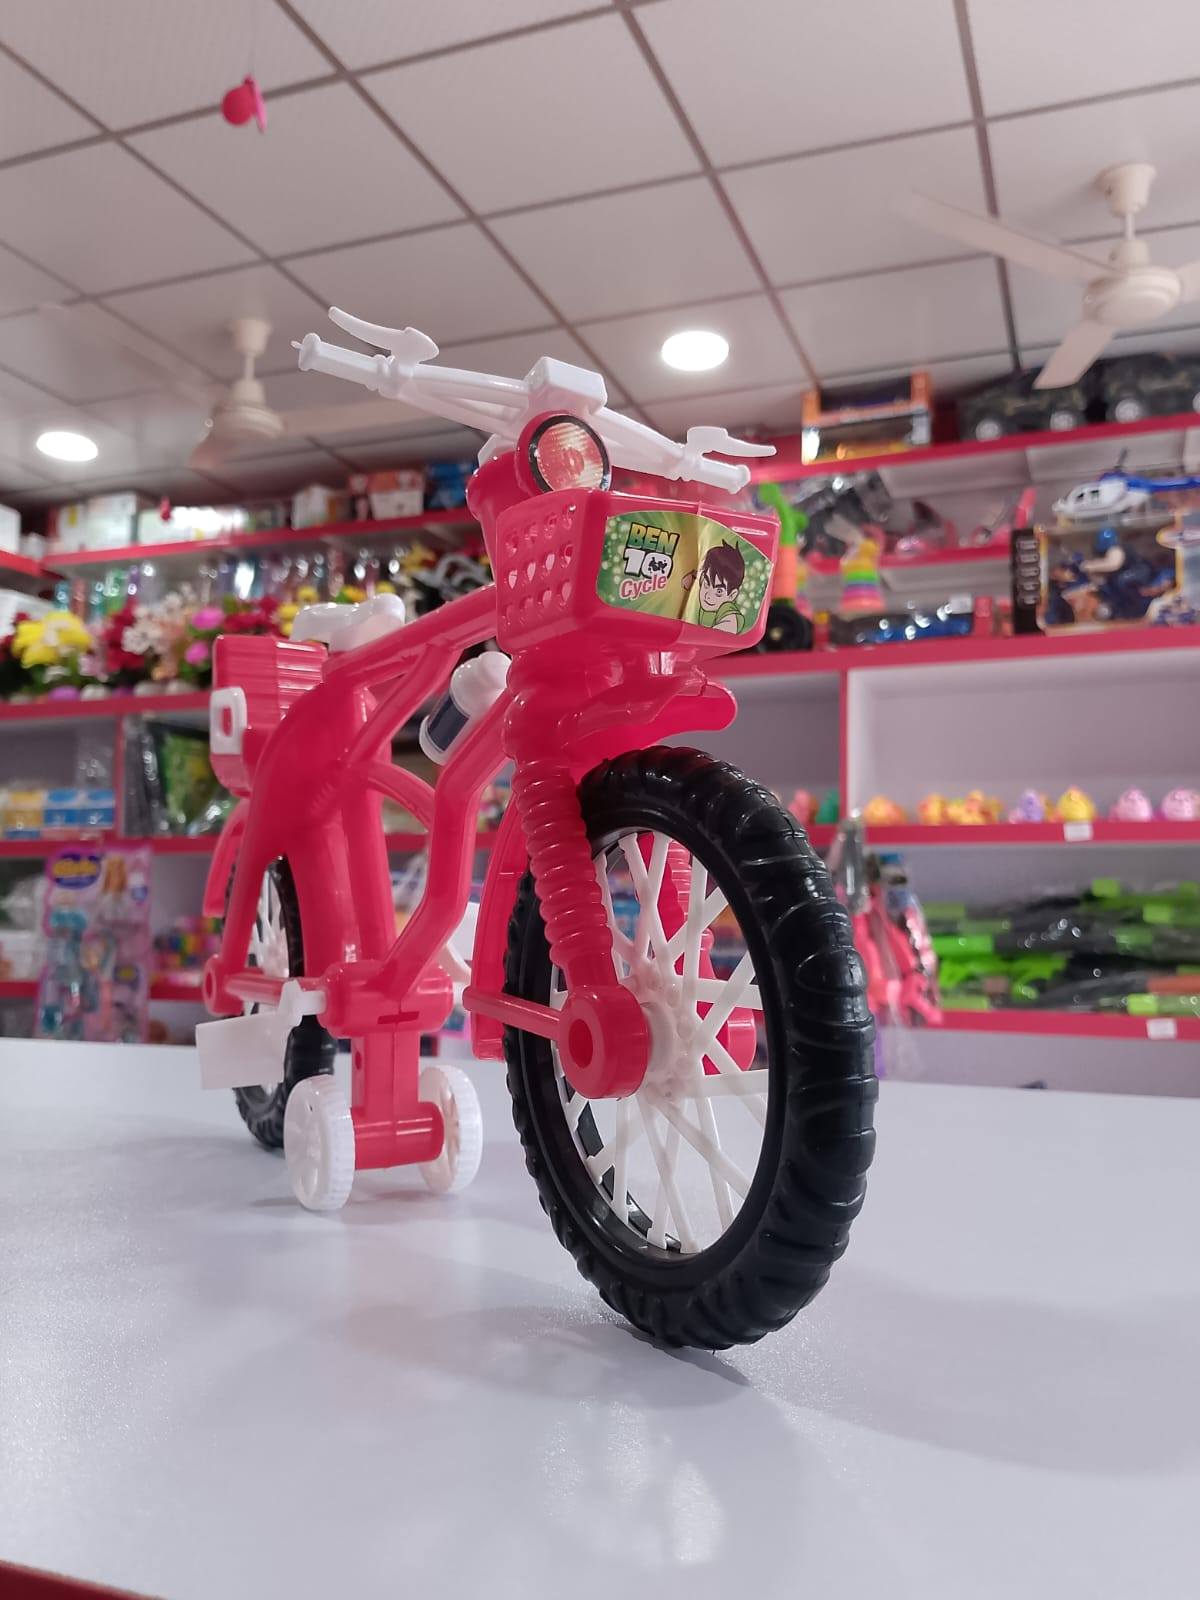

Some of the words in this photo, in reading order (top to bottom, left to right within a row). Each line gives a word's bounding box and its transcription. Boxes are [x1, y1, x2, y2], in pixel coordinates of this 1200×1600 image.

[627, 522, 680, 553] BEN
[623, 548, 673, 578] 10
[621, 575, 668, 598] Cycle
